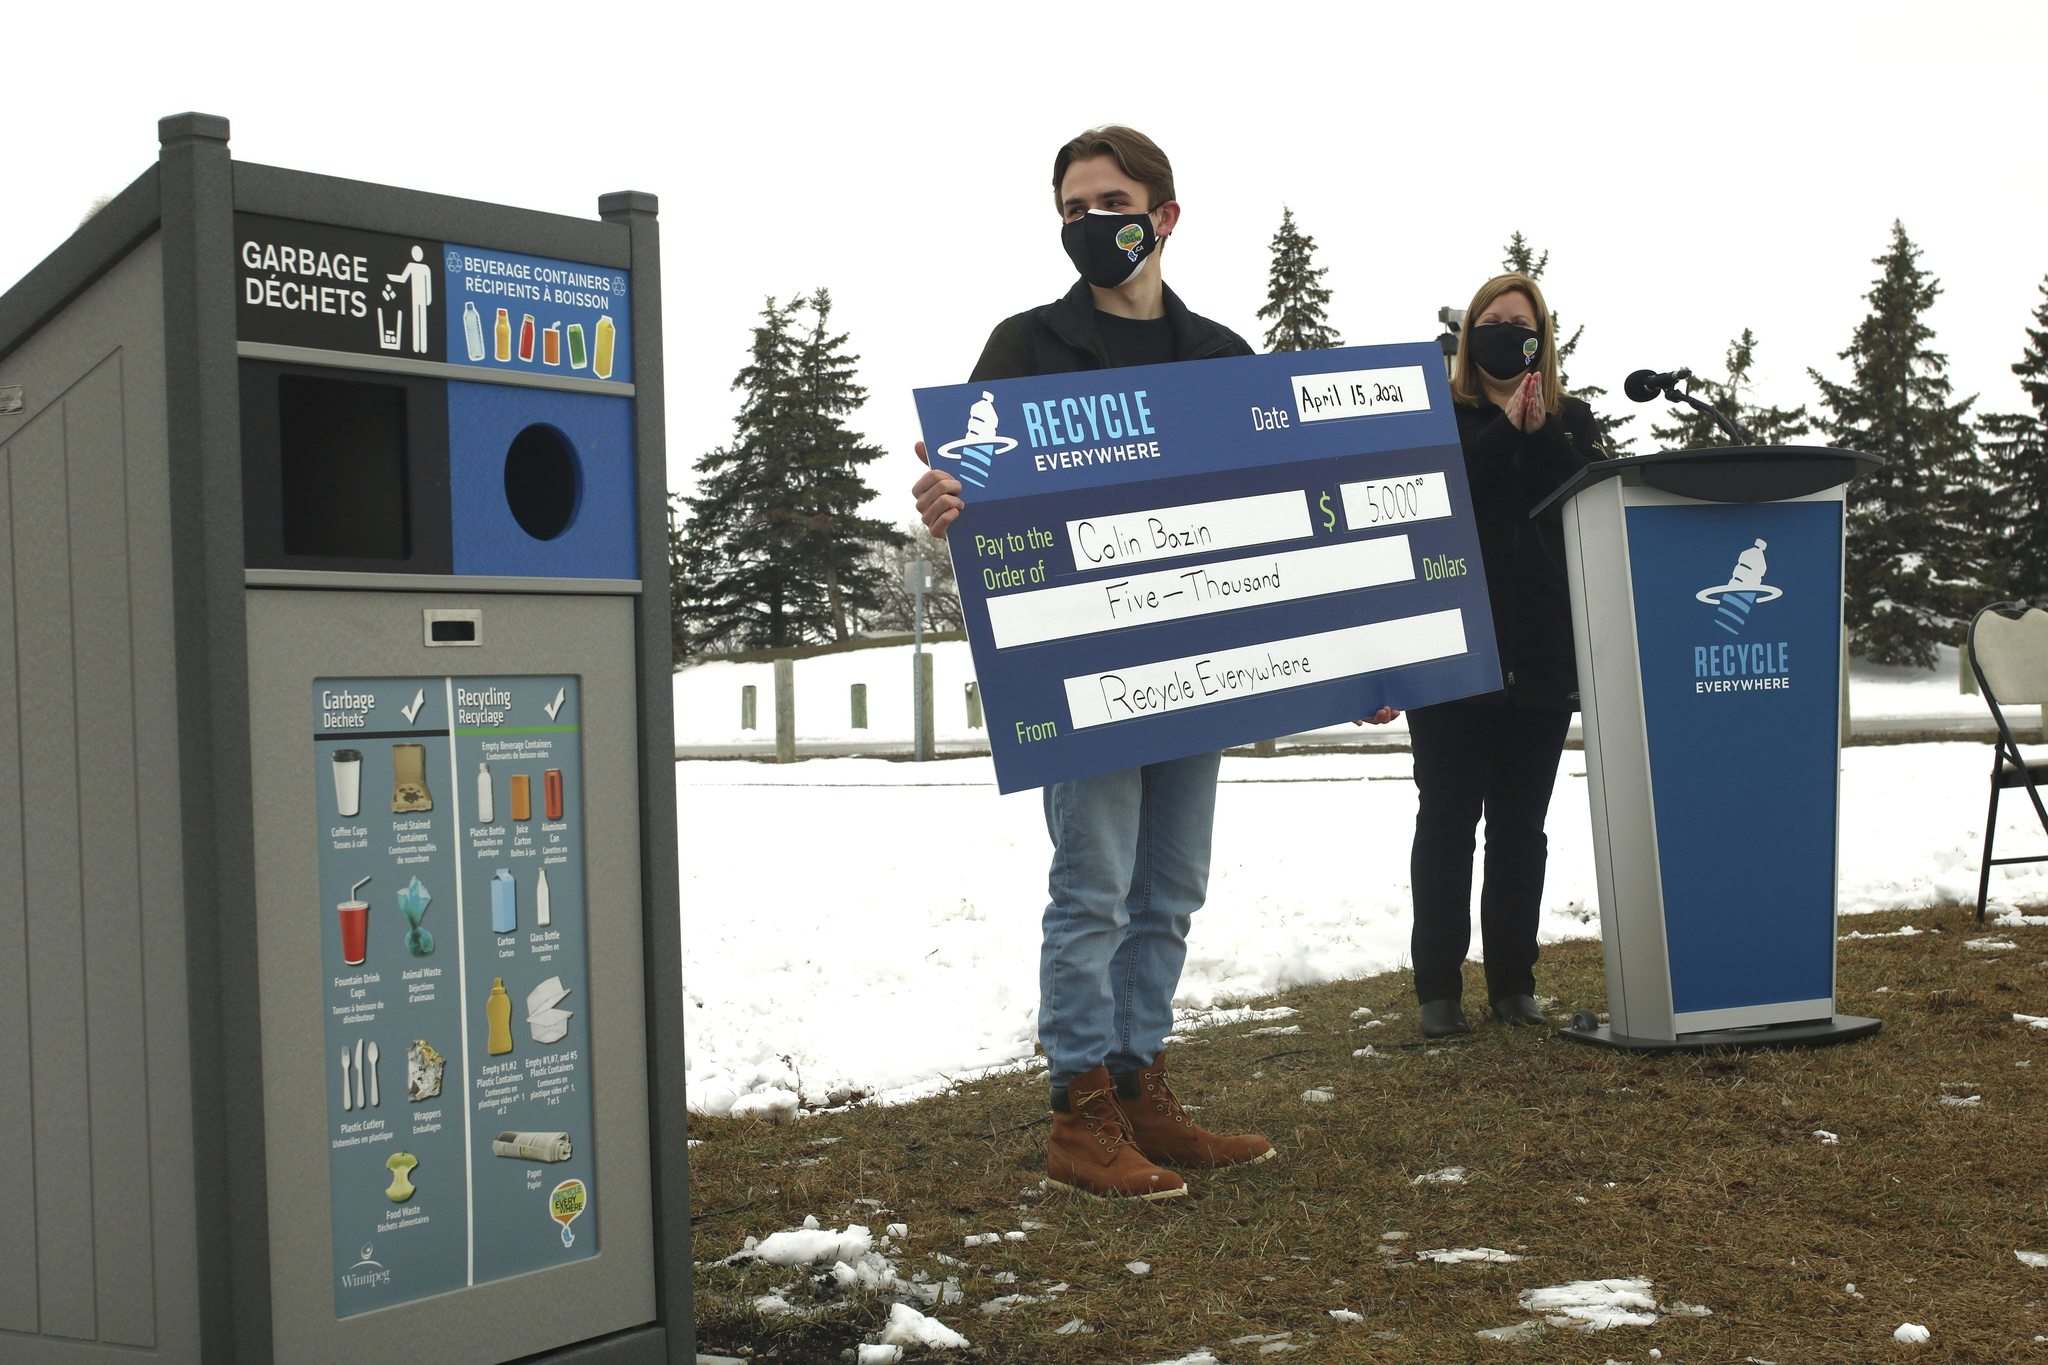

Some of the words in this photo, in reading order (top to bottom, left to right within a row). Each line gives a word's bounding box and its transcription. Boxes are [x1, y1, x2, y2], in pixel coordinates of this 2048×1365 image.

[242, 241, 369, 283] GARBAGE
[464, 256, 531, 280] BEVERAGE
[534, 266, 610, 292] CONTAINERS
[246, 275, 367, 318] DÉCHETS
[465, 274, 540, 300] RÉCIPIENTS
[544, 283, 552, 301] À
[555, 289, 609, 310] BOISSON
[1301, 384, 1342, 413] April
[1022, 389, 1156, 448] RECYCLE
[1252, 406, 1290, 431] Date
[1034, 441, 1161, 473] EVERYWHERE
[1319, 490, 1336, 533] $
[975, 533, 1005, 560] Pay
[1007, 531, 1025, 553] to
[1027, 526, 1055, 550] the
[1078, 521, 1142, 562] Colin
[1148, 518, 1212, 549] Bazin
[983, 565, 1026, 591] Order
[1030, 559, 1046, 583] of
[1422, 555, 1467, 582] Dollars
[1694, 641, 1789, 678] RECYCLE
[457, 688, 511, 710] Recycling
[1099, 671, 1194, 720] Recycle
[1195, 653, 1311, 697] Everywhere
[1696, 677, 1789, 694] EVERYWHERE
[322, 690, 375, 713] Garbage
[324, 712, 364, 728] Déchets
[459, 709, 504, 727] Recyclage
[1015, 720, 1057, 745] From
[350, 988, 366, 1000] Cups
[340, 1122, 362, 1134] Plastic
[362, 1119, 385, 1131] Cutlery
[386, 1208, 401, 1220] Food
[402, 1206, 421, 1217] Waste
[555, 1195, 576, 1209] EVERY
[559, 1202, 583, 1214] WHERE
[341, 1269, 391, 1289] Winnipeg
